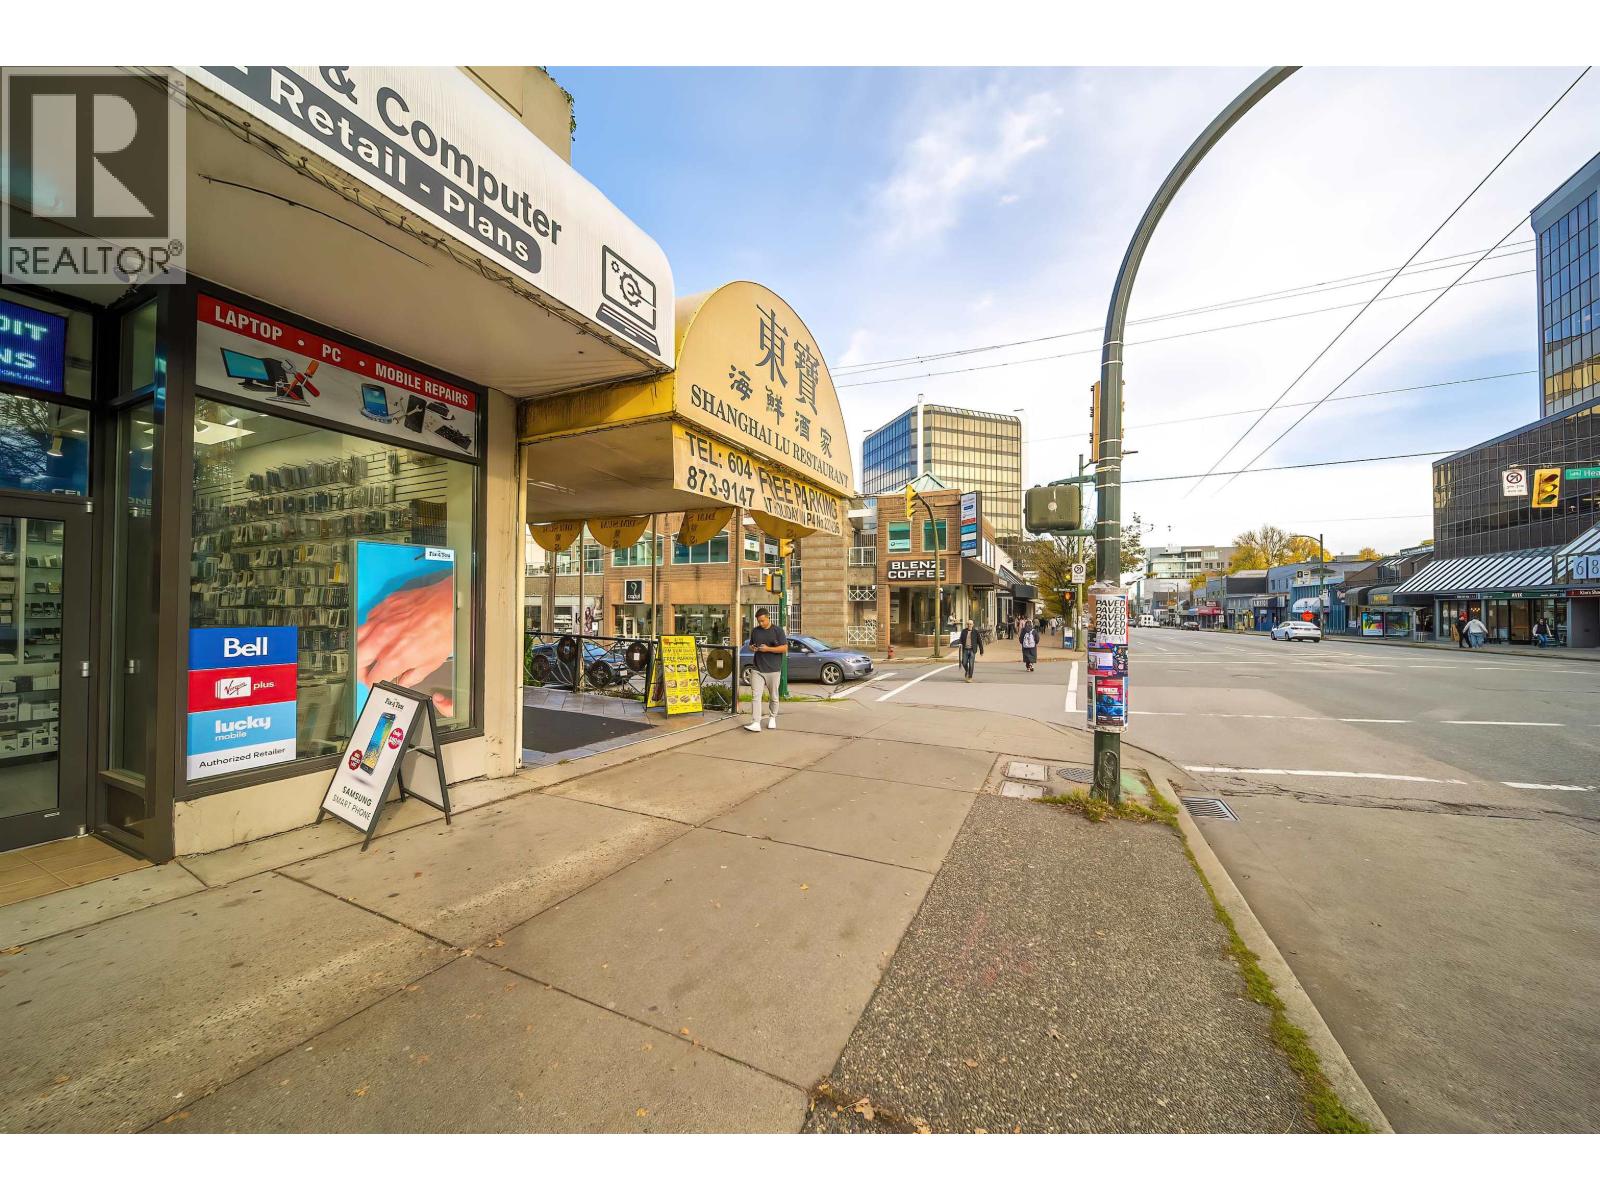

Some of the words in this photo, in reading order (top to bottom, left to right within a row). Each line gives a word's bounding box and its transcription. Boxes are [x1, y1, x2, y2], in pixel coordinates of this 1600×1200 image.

[270, 68, 407, 186] Retail
[443, 185, 529, 262] Plans
[376, 87, 562, 245] Computer
[214, 305, 283, 341] LAPTOP
[321, 343, 342, 363] PC
[375, 362, 421, 391] MOBILE
[424, 382, 469, 406] REPAIRS
[690, 383, 772, 446] SHANGHAI
[775, 436, 790, 456] LU
[793, 443, 849, 489] RESTAURANT
[685, 431, 723, 469] TEL:
[728, 451, 753, 480] 604
[687, 465, 755, 508] 873-9147
[793, 483, 839, 520] PARKING
[888, 569, 945, 579] COFFEE
[891, 560, 937, 570] BLENZ
[1096, 628, 1126, 636] PAVED
[223, 636, 269, 659] Bell
[223, 679, 249, 696] Virgin
[253, 680, 275, 692] plus
[214, 715, 272, 734] lucky
[214, 731, 247, 742] mobile
[198, 753, 252, 769] Authorized
[253, 746, 287, 760] Retailer
[331, 794, 352, 809] SMART
[351, 804, 372, 821] PHONE
[341, 786, 373, 807] SAMSUNG
